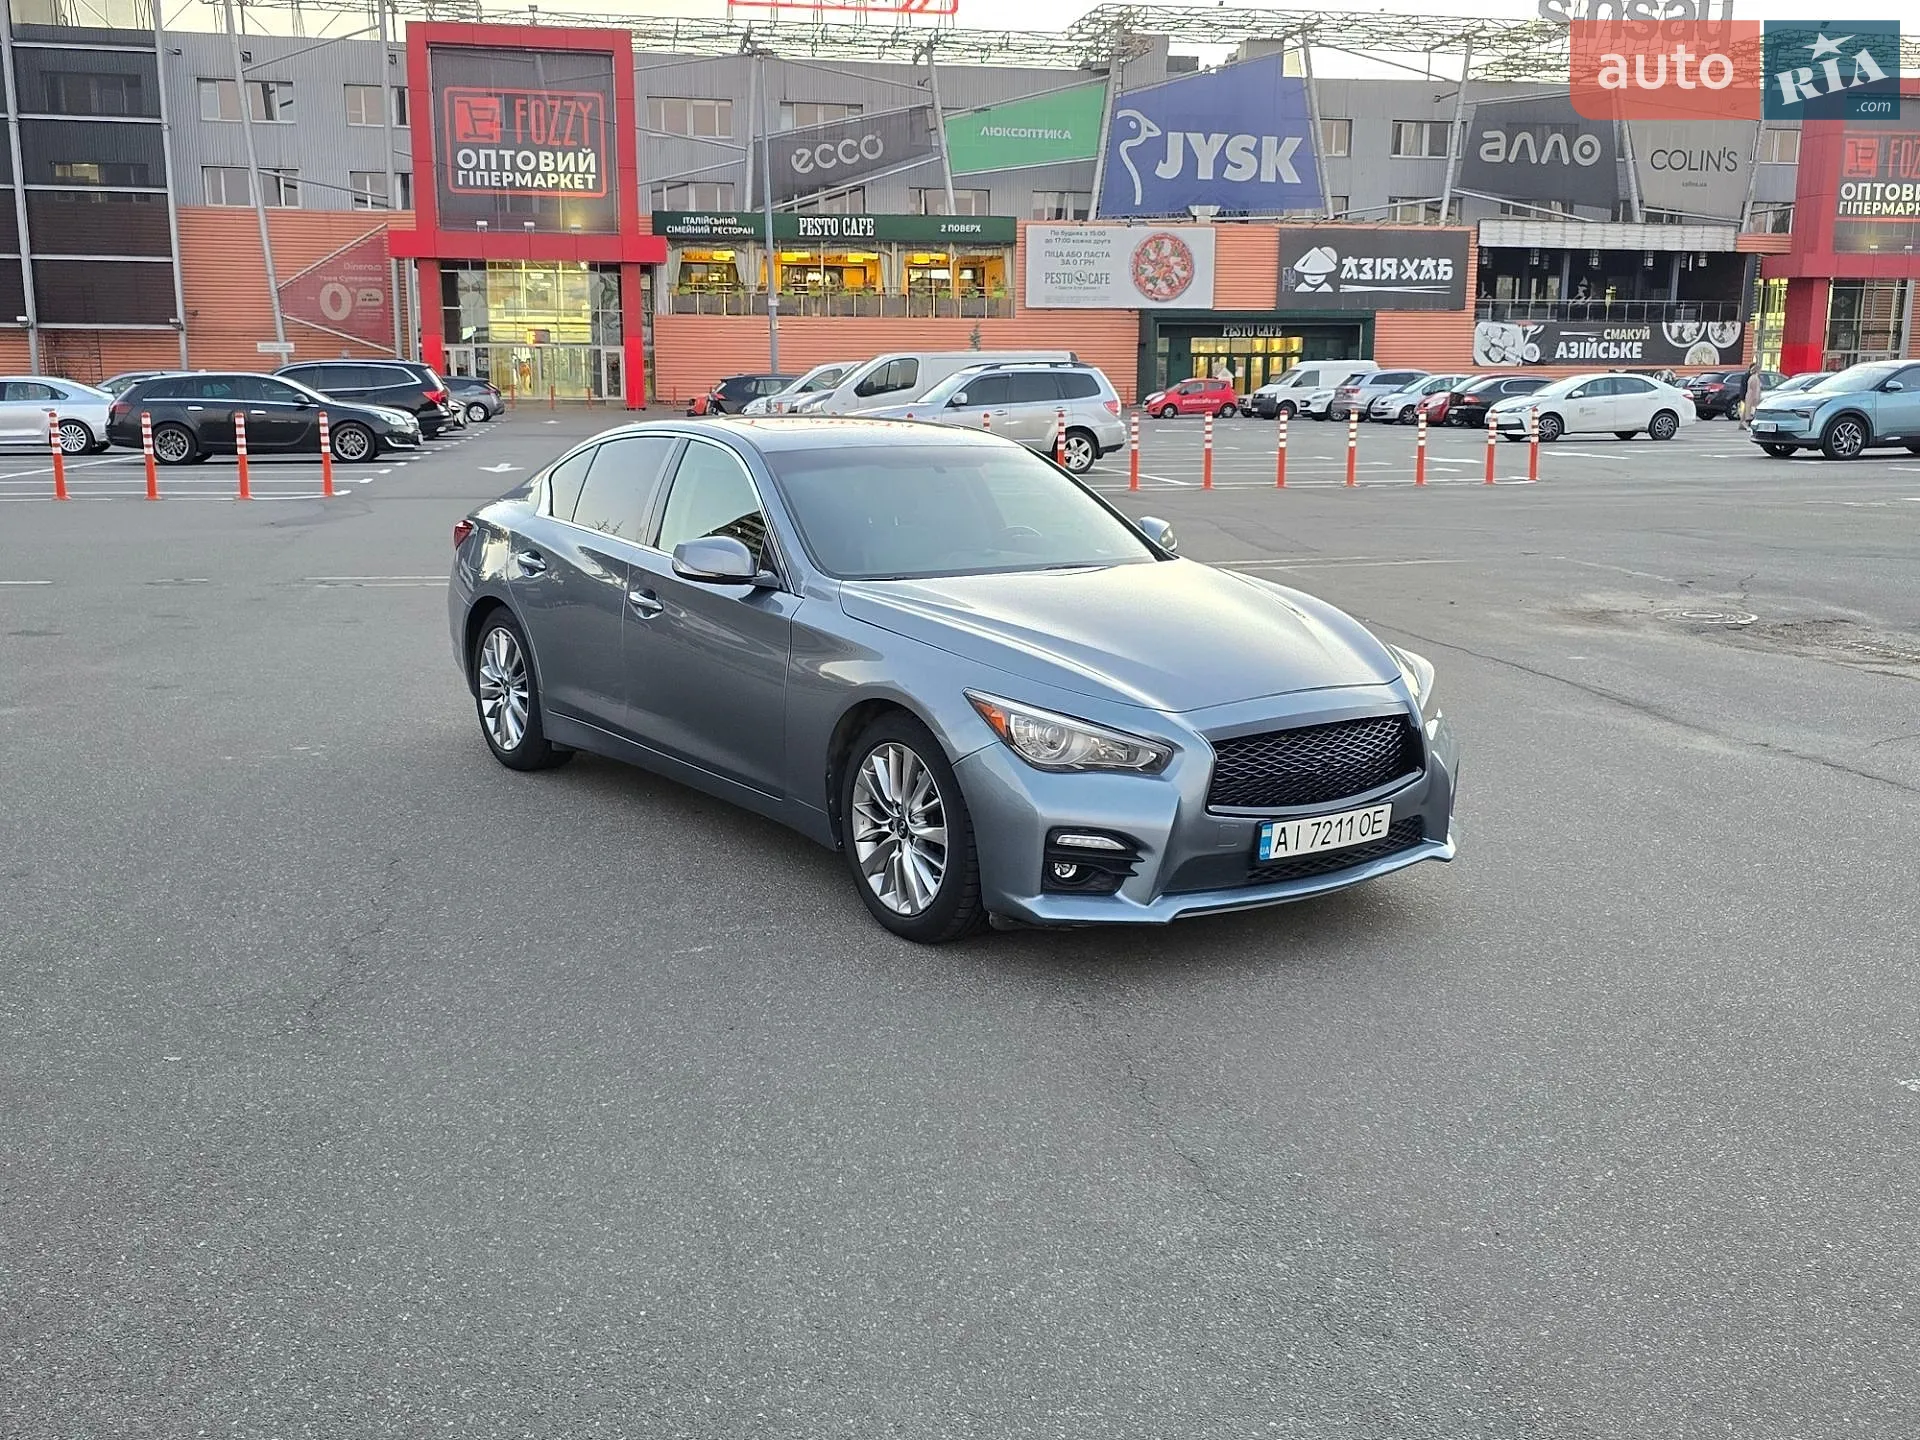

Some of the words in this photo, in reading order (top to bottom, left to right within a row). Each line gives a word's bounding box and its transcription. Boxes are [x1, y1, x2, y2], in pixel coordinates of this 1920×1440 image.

[514, 98, 593, 147] FOZZY
[979, 126, 1072, 140] ЛЮКСОПТИКА
[456, 148, 597, 173] ОПТОВИЙ
[790, 133, 884, 174] ecco
[1154, 131, 1303, 184] JYSK
[1650, 145, 1738, 173] COLIN'S
[456, 170, 597, 190] ГІПЕРМАРКЕТ
[666, 224, 710, 235] СІМЕЙНИЙ
[712, 226, 754, 235] РЕСТОРАН
[682, 216, 738, 226] ІТАЛІЙСЬКИЙ
[798, 217, 839, 237] PESTO
[842, 217, 875, 237] CAFE
[940, 224, 947, 233] 2
[948, 224, 981, 233] ПОВЕРХ
[1044, 251, 1065, 259] ПІЦА
[1044, 272, 1073, 285] PESTO
[1088, 272, 1111, 285] CAFE
[1222, 323, 1255, 337] PESTO
[1256, 324, 1282, 338] CAFE
[1603, 326, 1651, 341] СМАКУЙ
[1554, 338, 1643, 360] АЗІЙСЬКЕ
[1274, 825, 1301, 852] AI
[1310, 815, 1355, 848] 7211
[1359, 809, 1385, 837] OE
